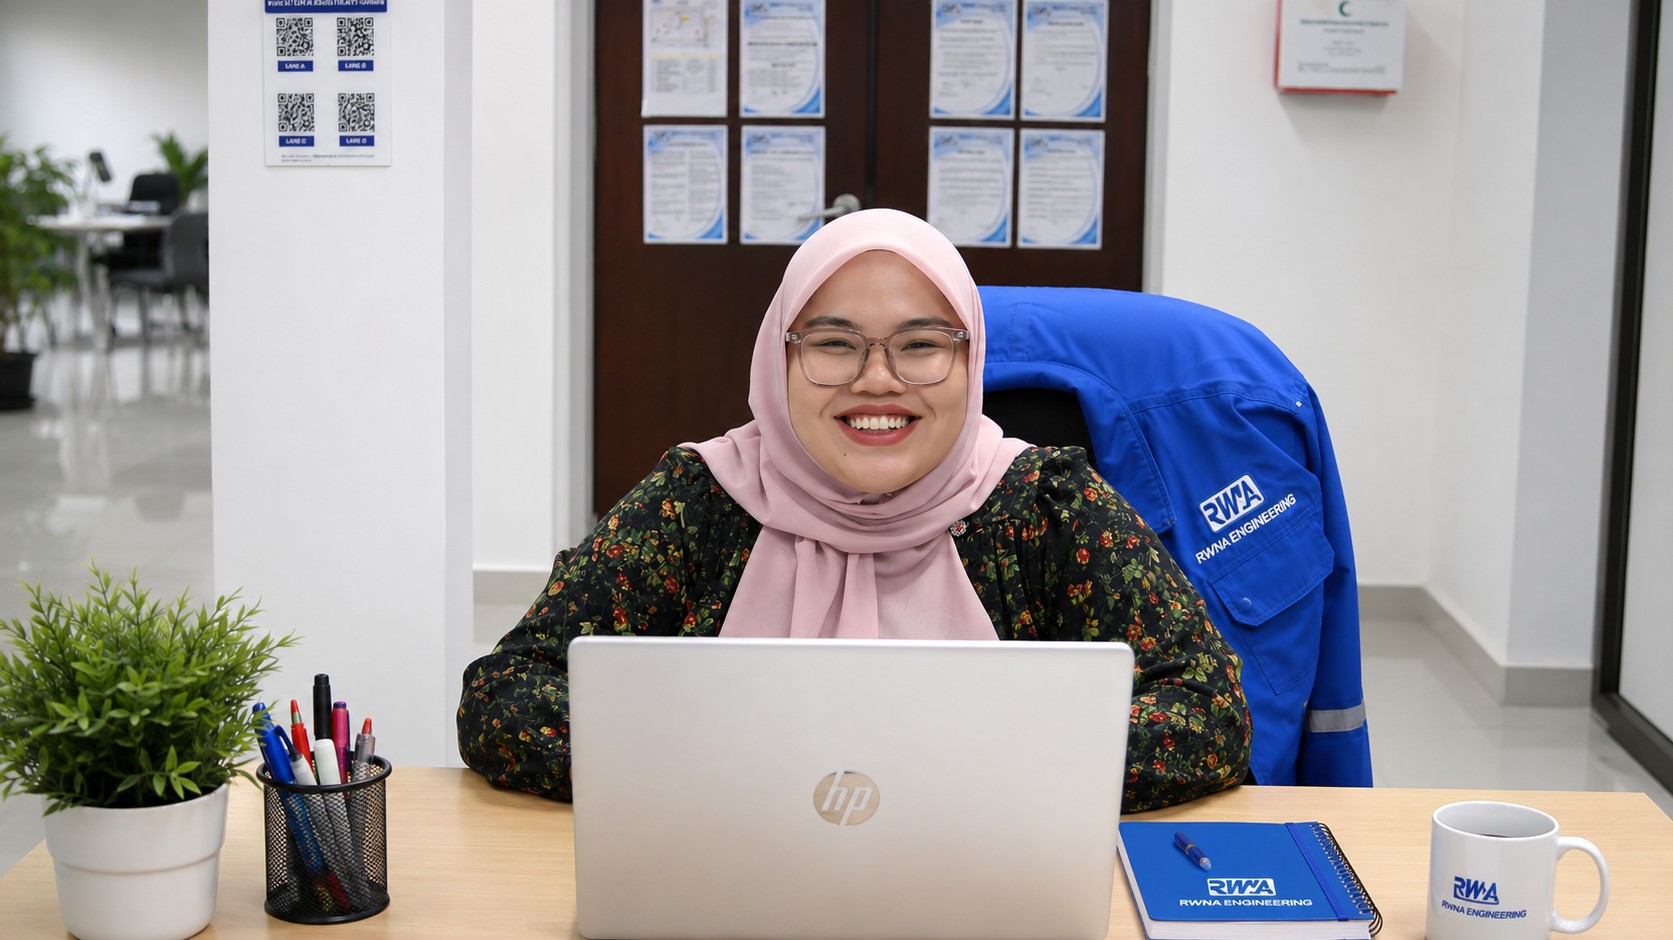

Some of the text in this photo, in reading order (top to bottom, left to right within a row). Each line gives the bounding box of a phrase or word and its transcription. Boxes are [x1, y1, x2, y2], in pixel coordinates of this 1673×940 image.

[1195, 493, 1296, 564] RWNA ENGINEERING
[821, 770, 873, 826] hp
[1179, 899, 1313, 907] RWNA ENGINEERING
[1441, 900, 1527, 919] RWNA ENGINEERING
